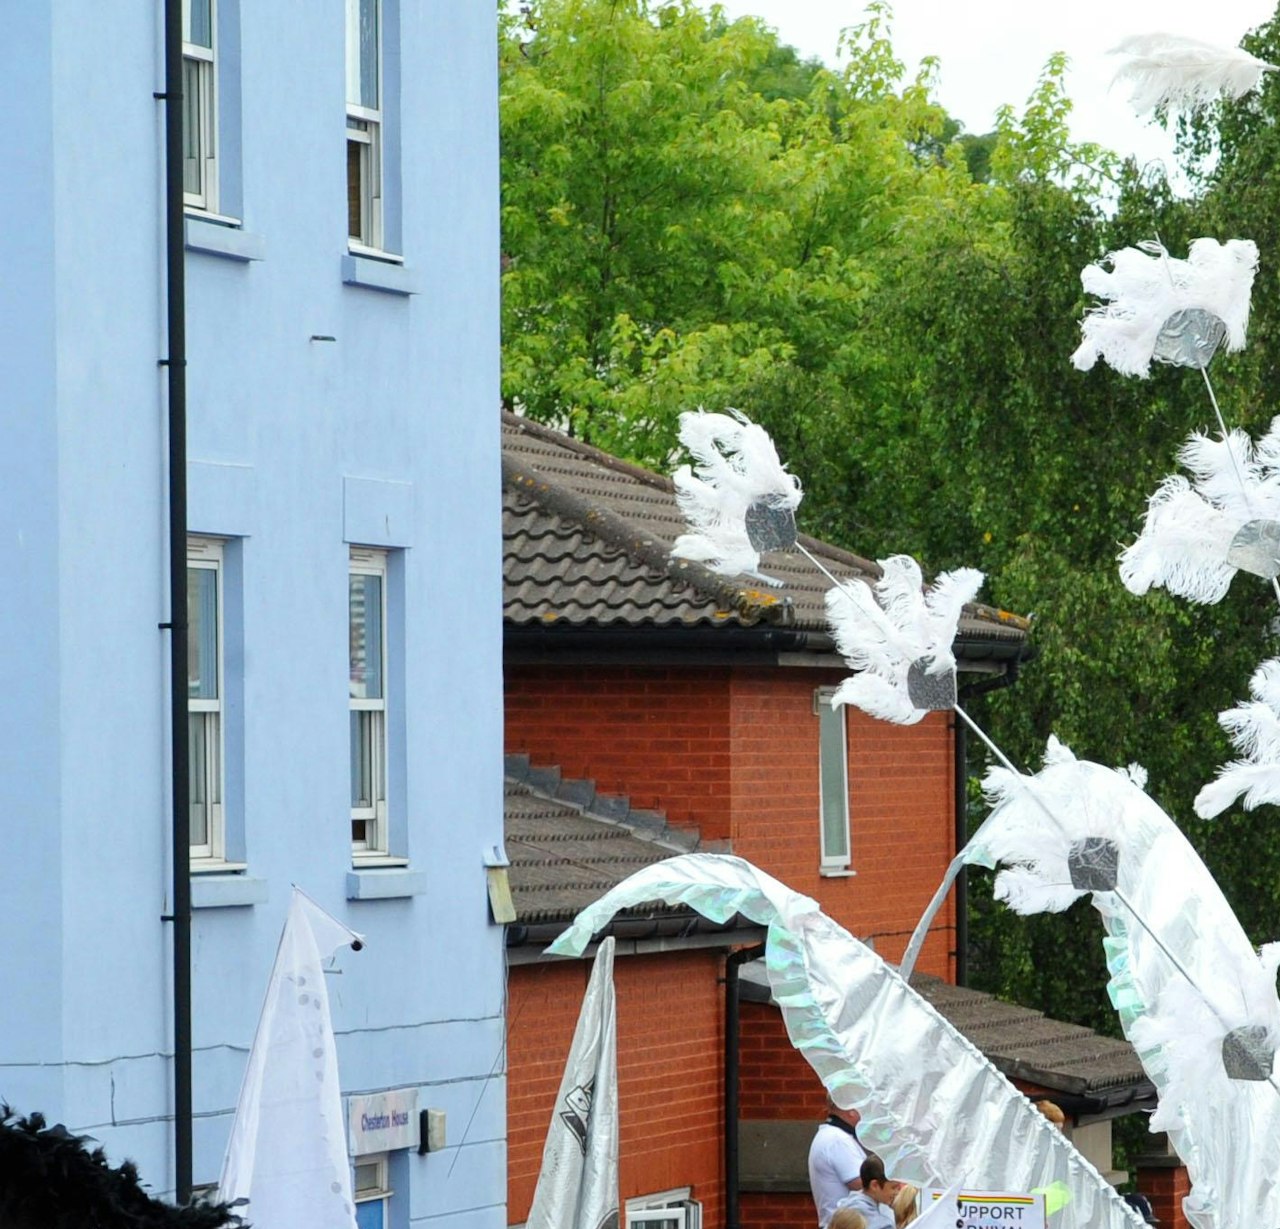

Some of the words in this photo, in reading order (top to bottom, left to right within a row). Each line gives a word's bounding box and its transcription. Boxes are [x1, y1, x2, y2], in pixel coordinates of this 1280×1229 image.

[361, 1112, 390, 1132] Chesterton
[391, 1108, 409, 1128] House
[959, 1206, 1025, 1220] UPPORT
